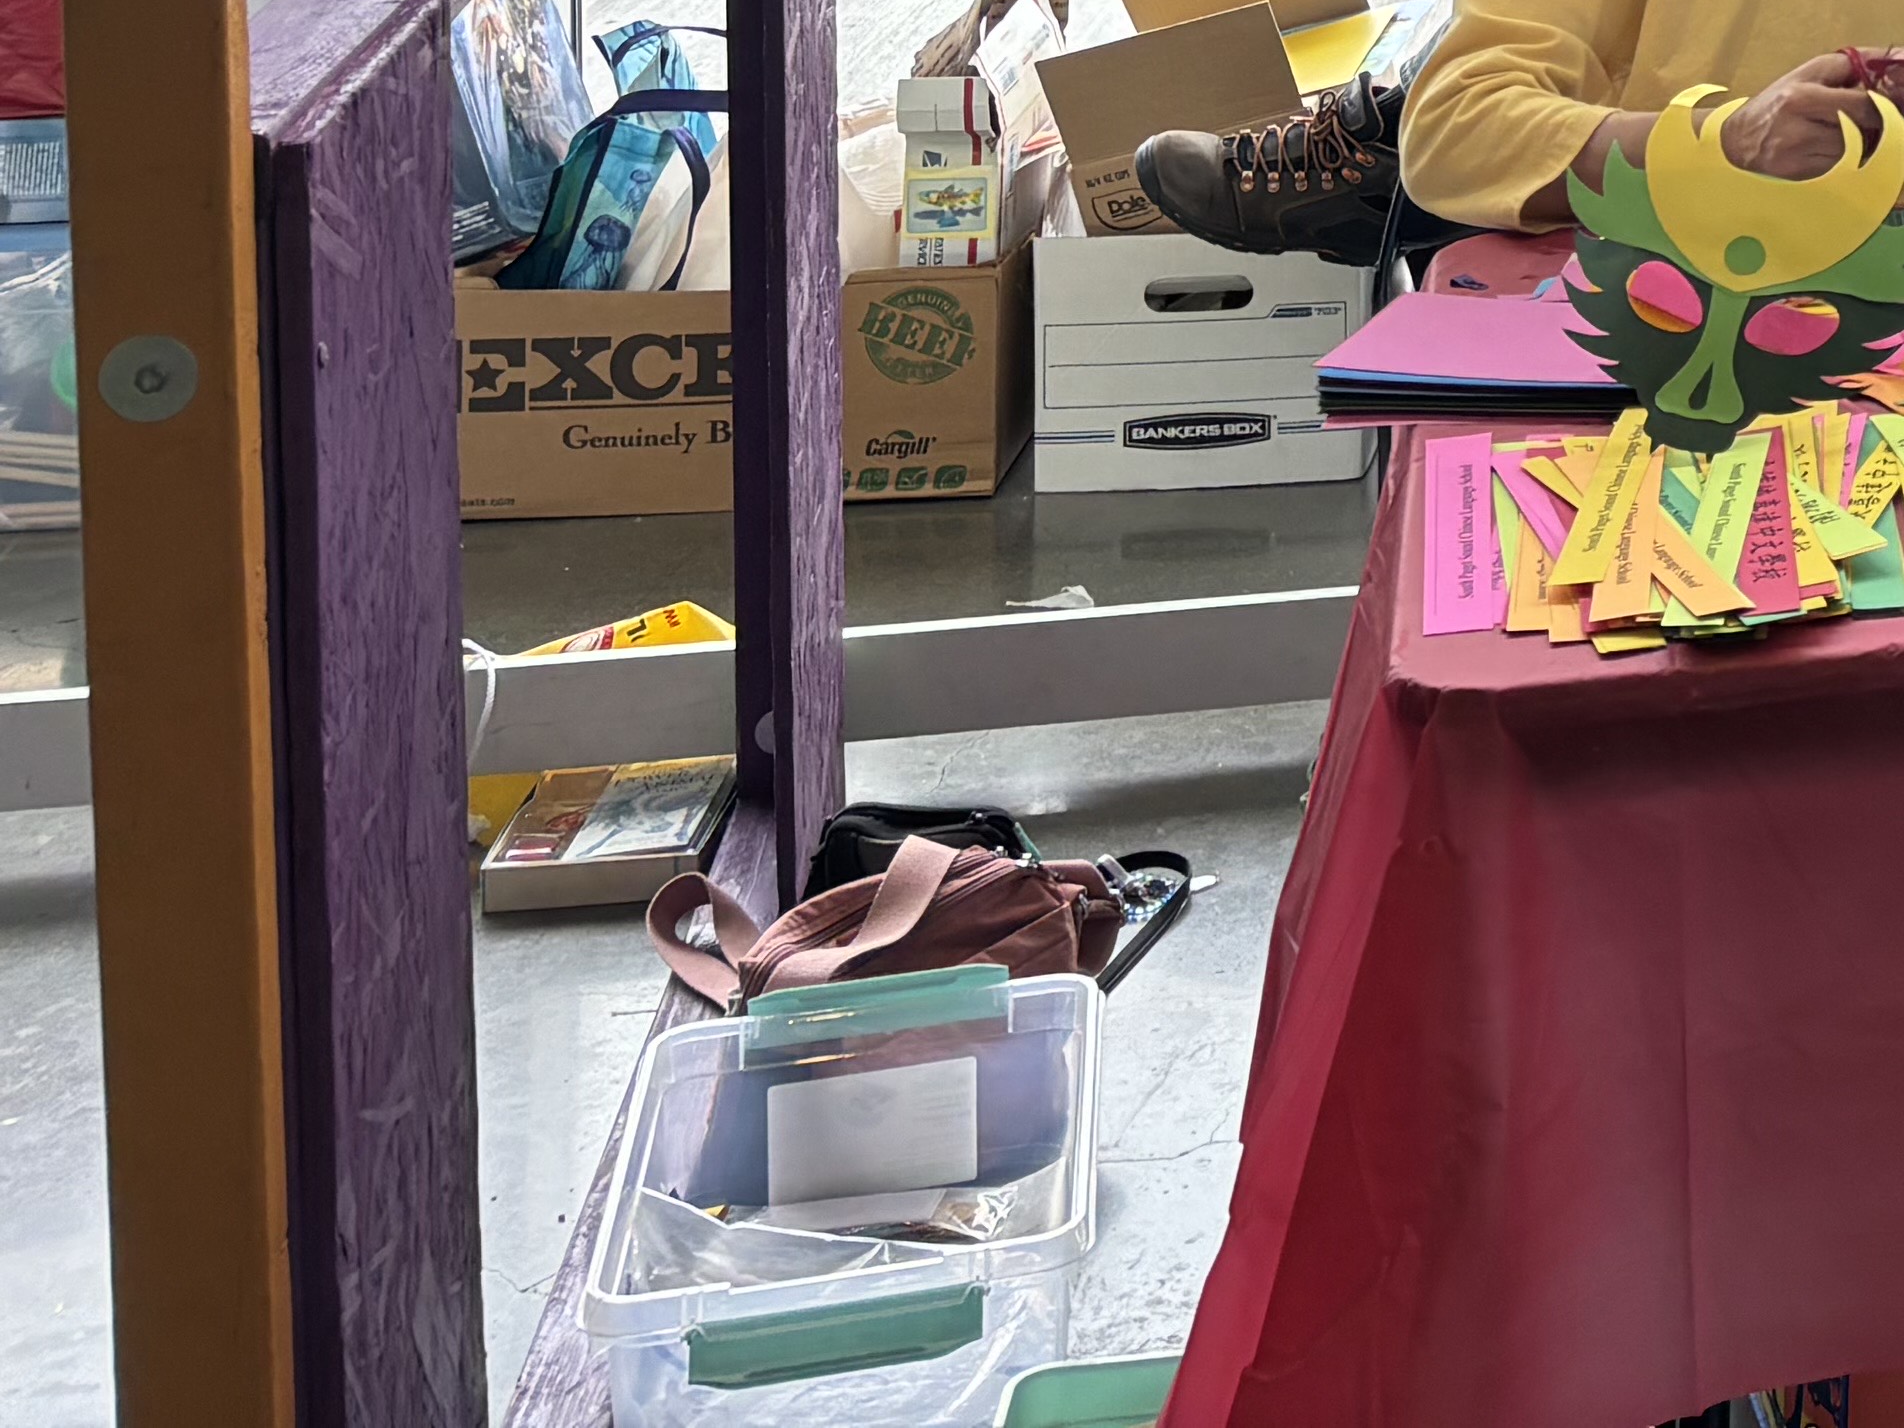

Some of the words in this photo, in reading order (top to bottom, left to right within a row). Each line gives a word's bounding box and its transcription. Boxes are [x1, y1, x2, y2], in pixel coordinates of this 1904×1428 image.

[1107, 195, 1149, 215] Dole
[562, 421, 697, 454] Genuinely
[1131, 423, 1221, 440] BANKERS
[1223, 420, 1263, 436] BOX
[865, 436, 931, 459] Cargill
